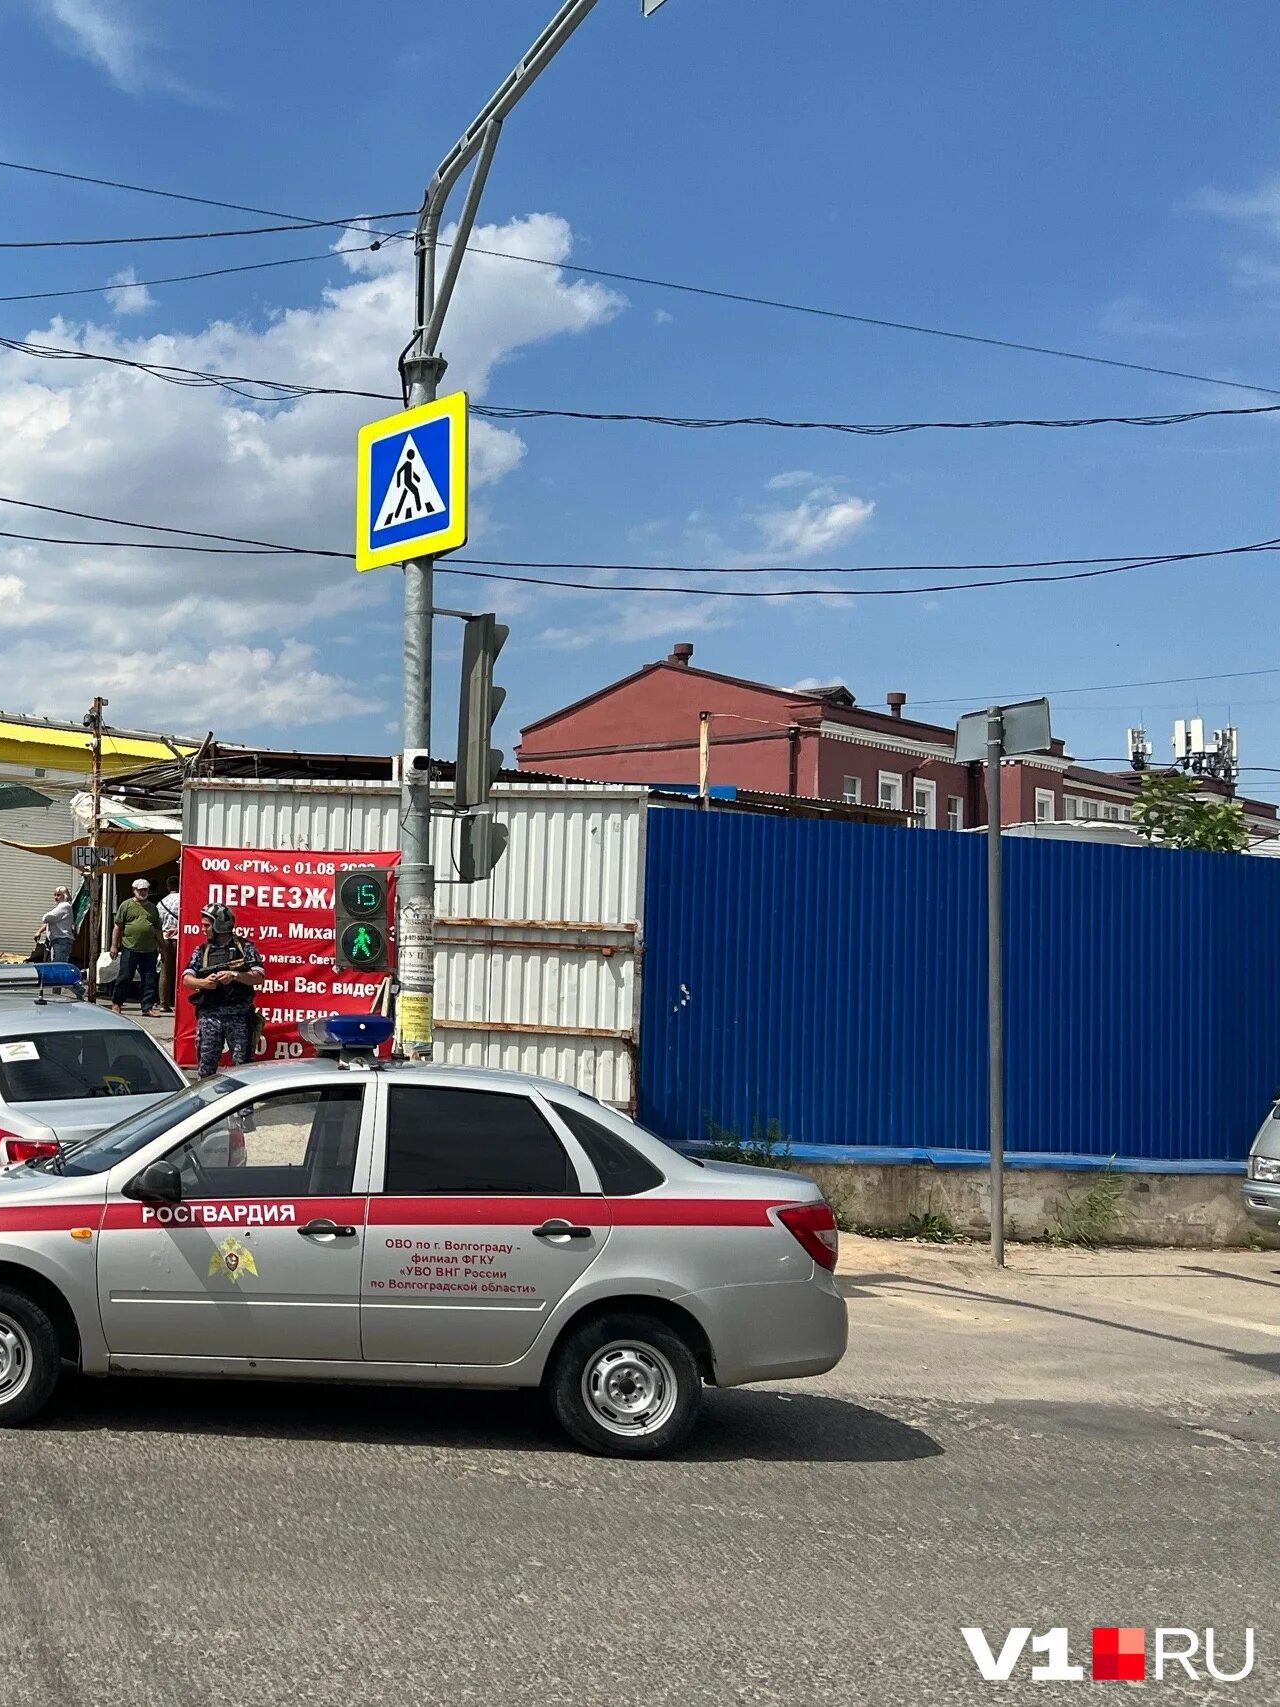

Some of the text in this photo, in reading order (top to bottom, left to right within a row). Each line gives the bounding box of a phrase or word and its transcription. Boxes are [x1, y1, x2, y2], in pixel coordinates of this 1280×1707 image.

[201, 858, 231, 872] ООО
[234, 860, 279, 873] «РТК»
[282, 864, 291, 874] с
[208, 884, 336, 909] ПЕРЕЕЗЖ
[357, 884, 377, 906] 15
[184, 924, 200, 935] по
[259, 926, 283, 939] ул.
[268, 954, 306, 965] магаз.
[295, 976, 327, 994] Вас
[332, 982, 383, 997] видет
[275, 1041, 303, 1059] до
[141, 1204, 296, 1225] РОСГВАРДИЯ
[385, 1239, 412, 1249] ОВО
[416, 1241, 430, 1250] по
[445, 1241, 513, 1254] Волгограду
[411, 1253, 494, 1265] филиал ФГКУ
[400, 1266, 507, 1279] «УВО ВНГ России
[370, 1279, 536, 1293] по Волгоградской области»
